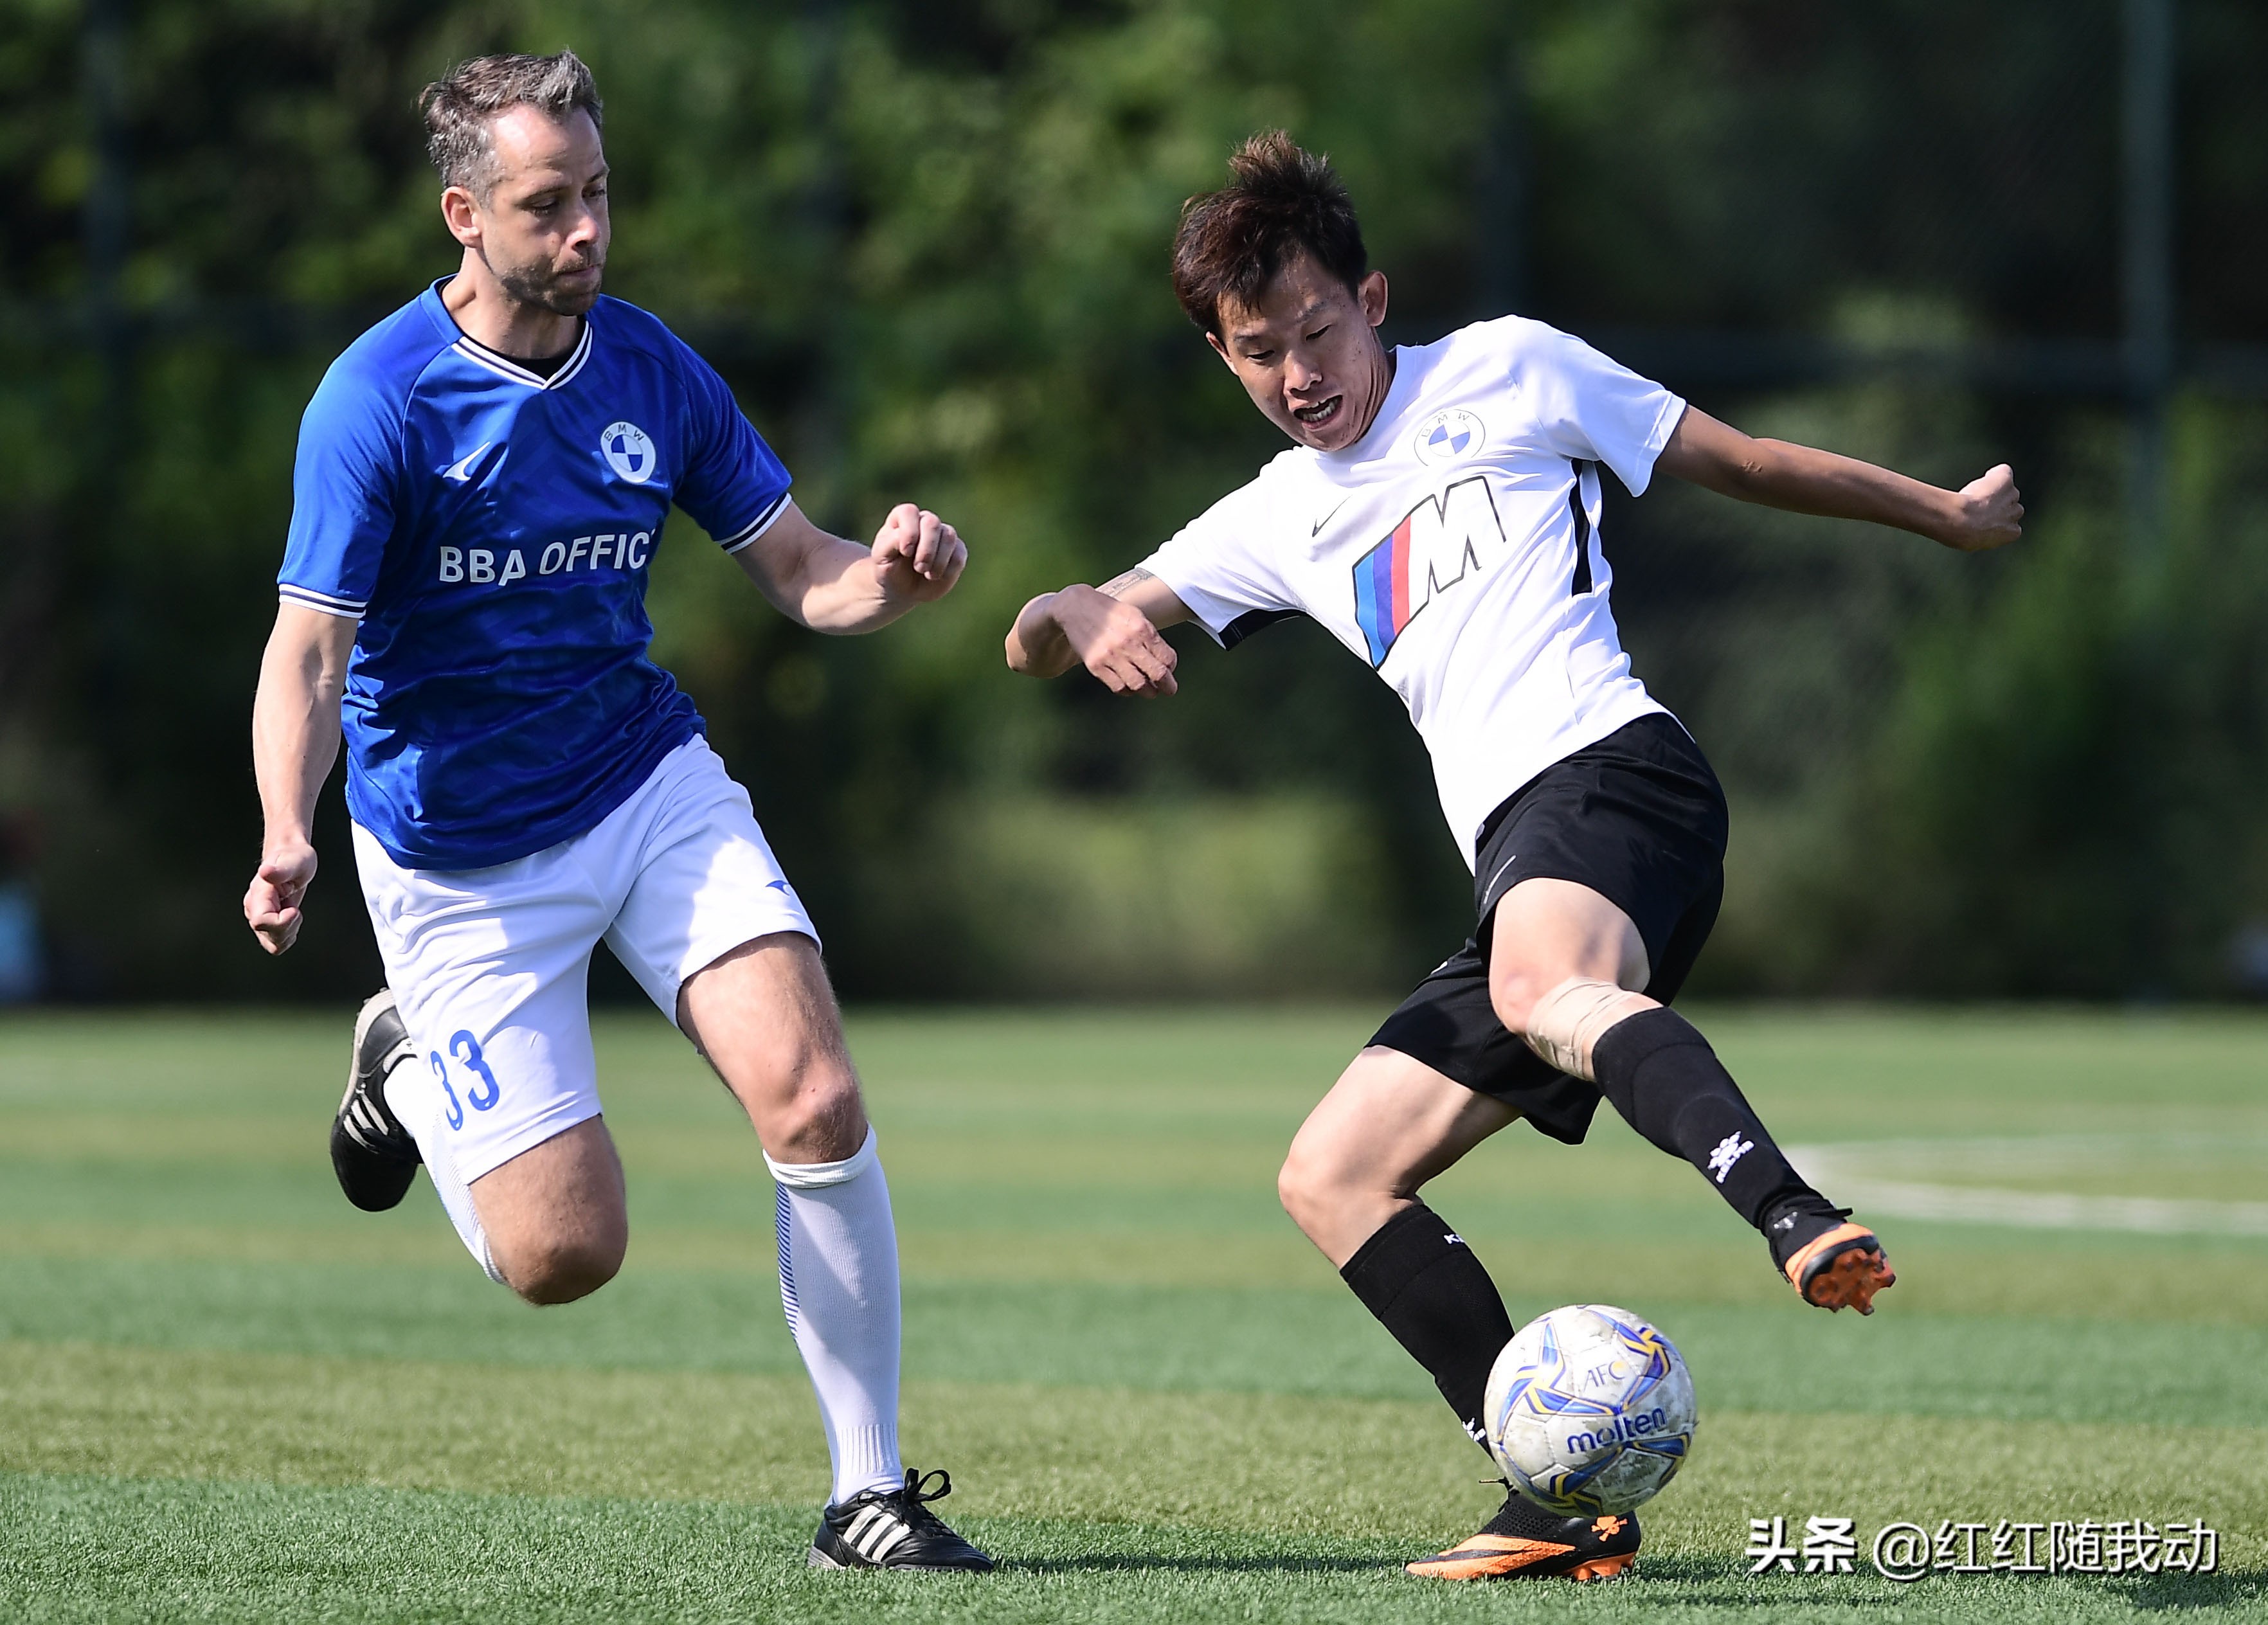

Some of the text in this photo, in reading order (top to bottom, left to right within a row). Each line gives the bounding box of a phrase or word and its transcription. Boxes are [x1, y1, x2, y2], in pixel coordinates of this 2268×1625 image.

[604, 424, 645, 442] BMW
[439, 528, 656, 586] BBA OFFIC
[430, 1029, 500, 1131] 33
[1583, 1360, 1626, 1393] AFC
[1567, 1407, 1667, 1455] molten
